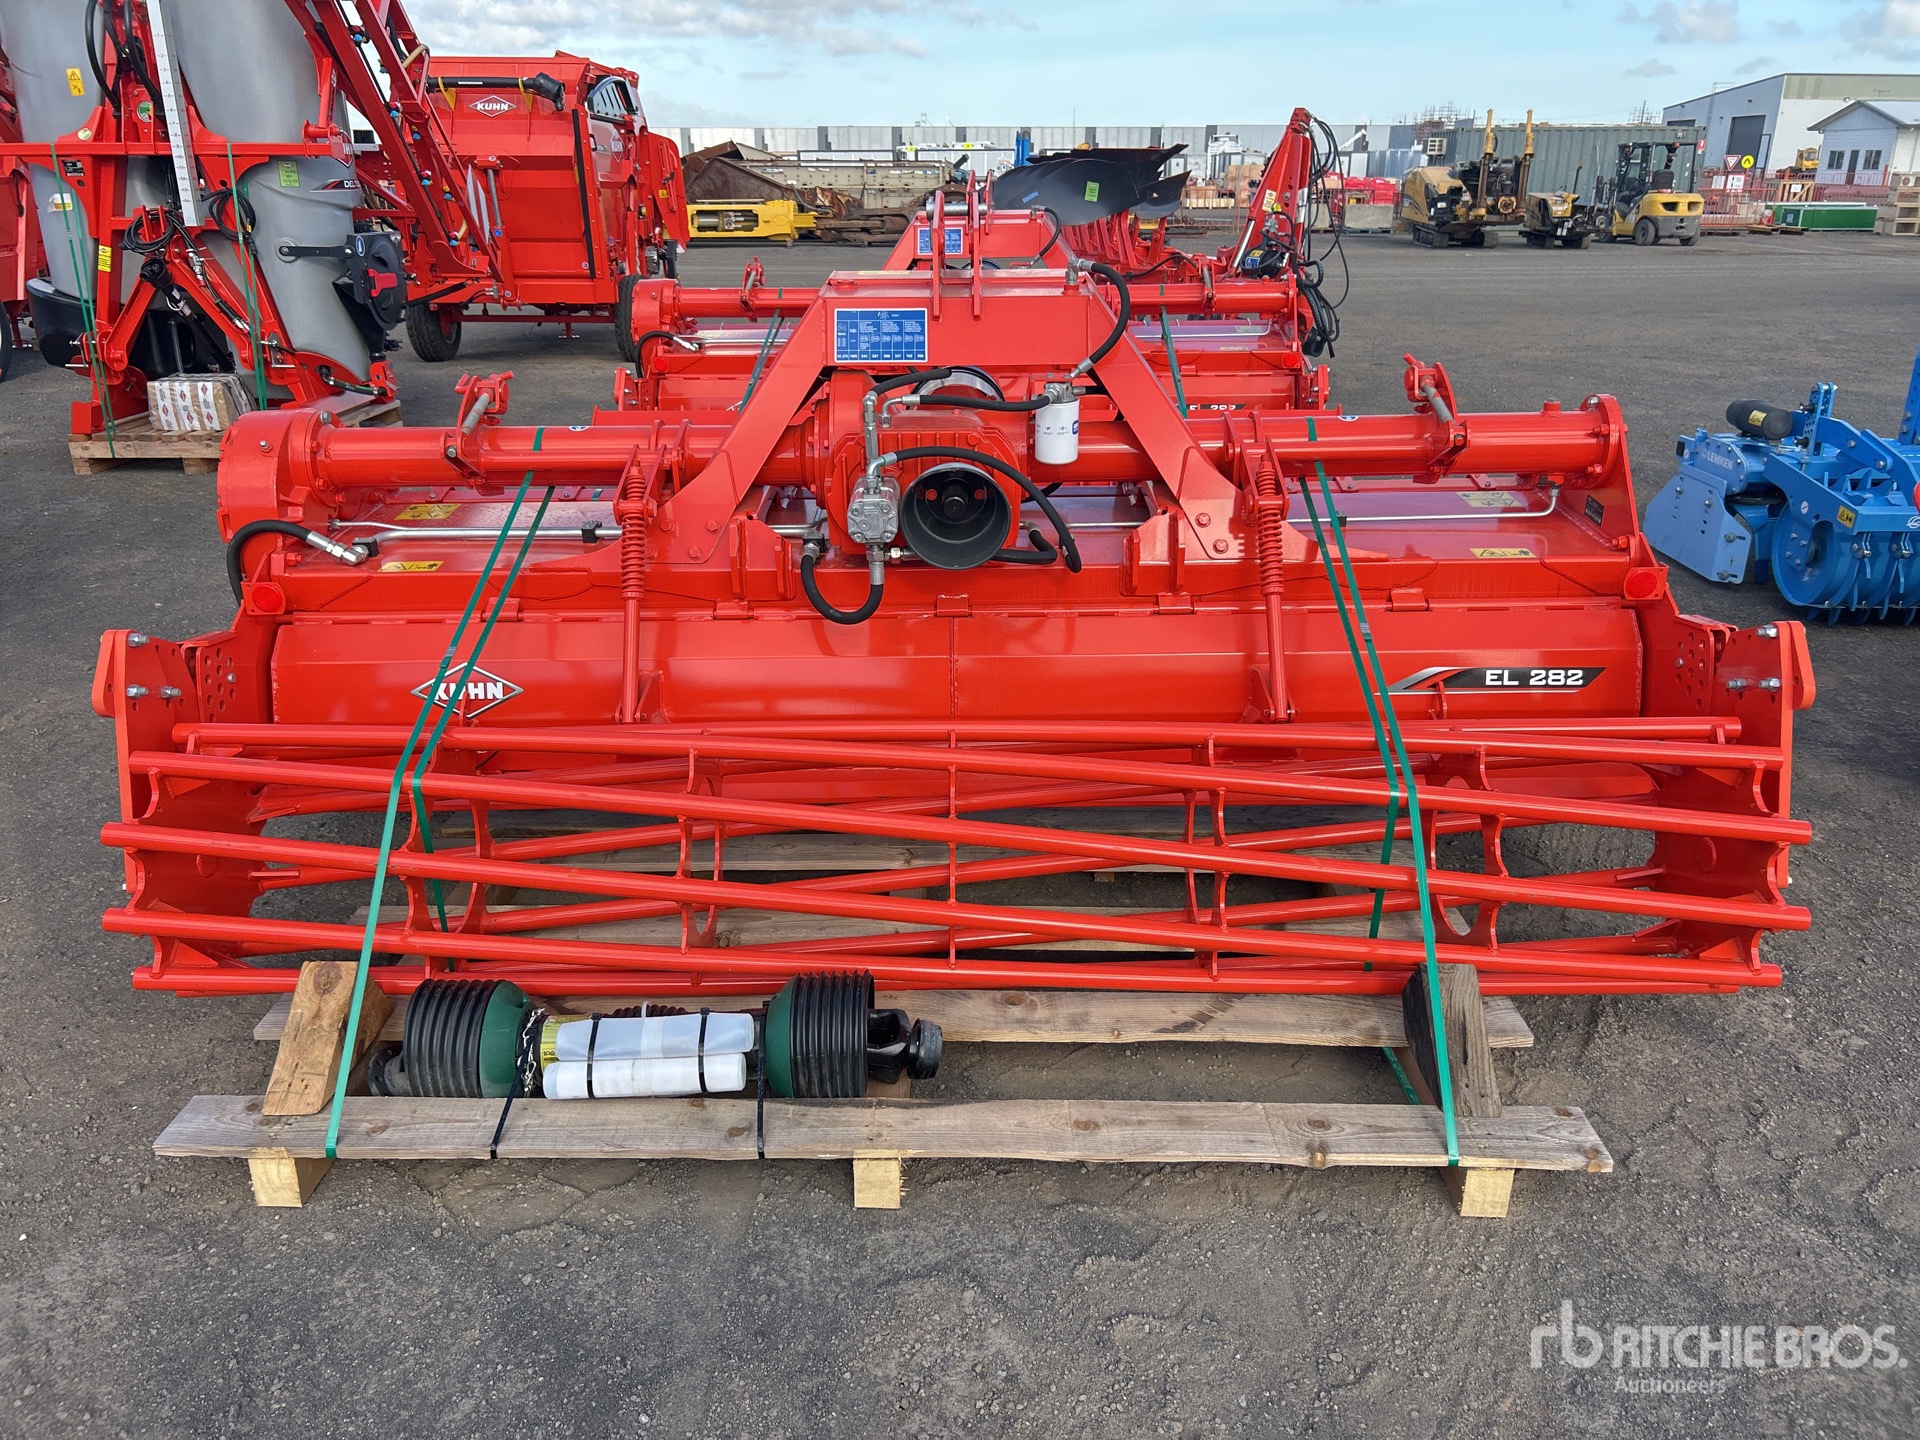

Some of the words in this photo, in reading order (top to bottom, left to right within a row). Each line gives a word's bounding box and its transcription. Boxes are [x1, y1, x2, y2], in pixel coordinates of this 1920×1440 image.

[1706, 450, 1734, 471] LEMKEN
[1485, 669, 1519, 686] EL
[1529, 669, 1584, 686] 282
